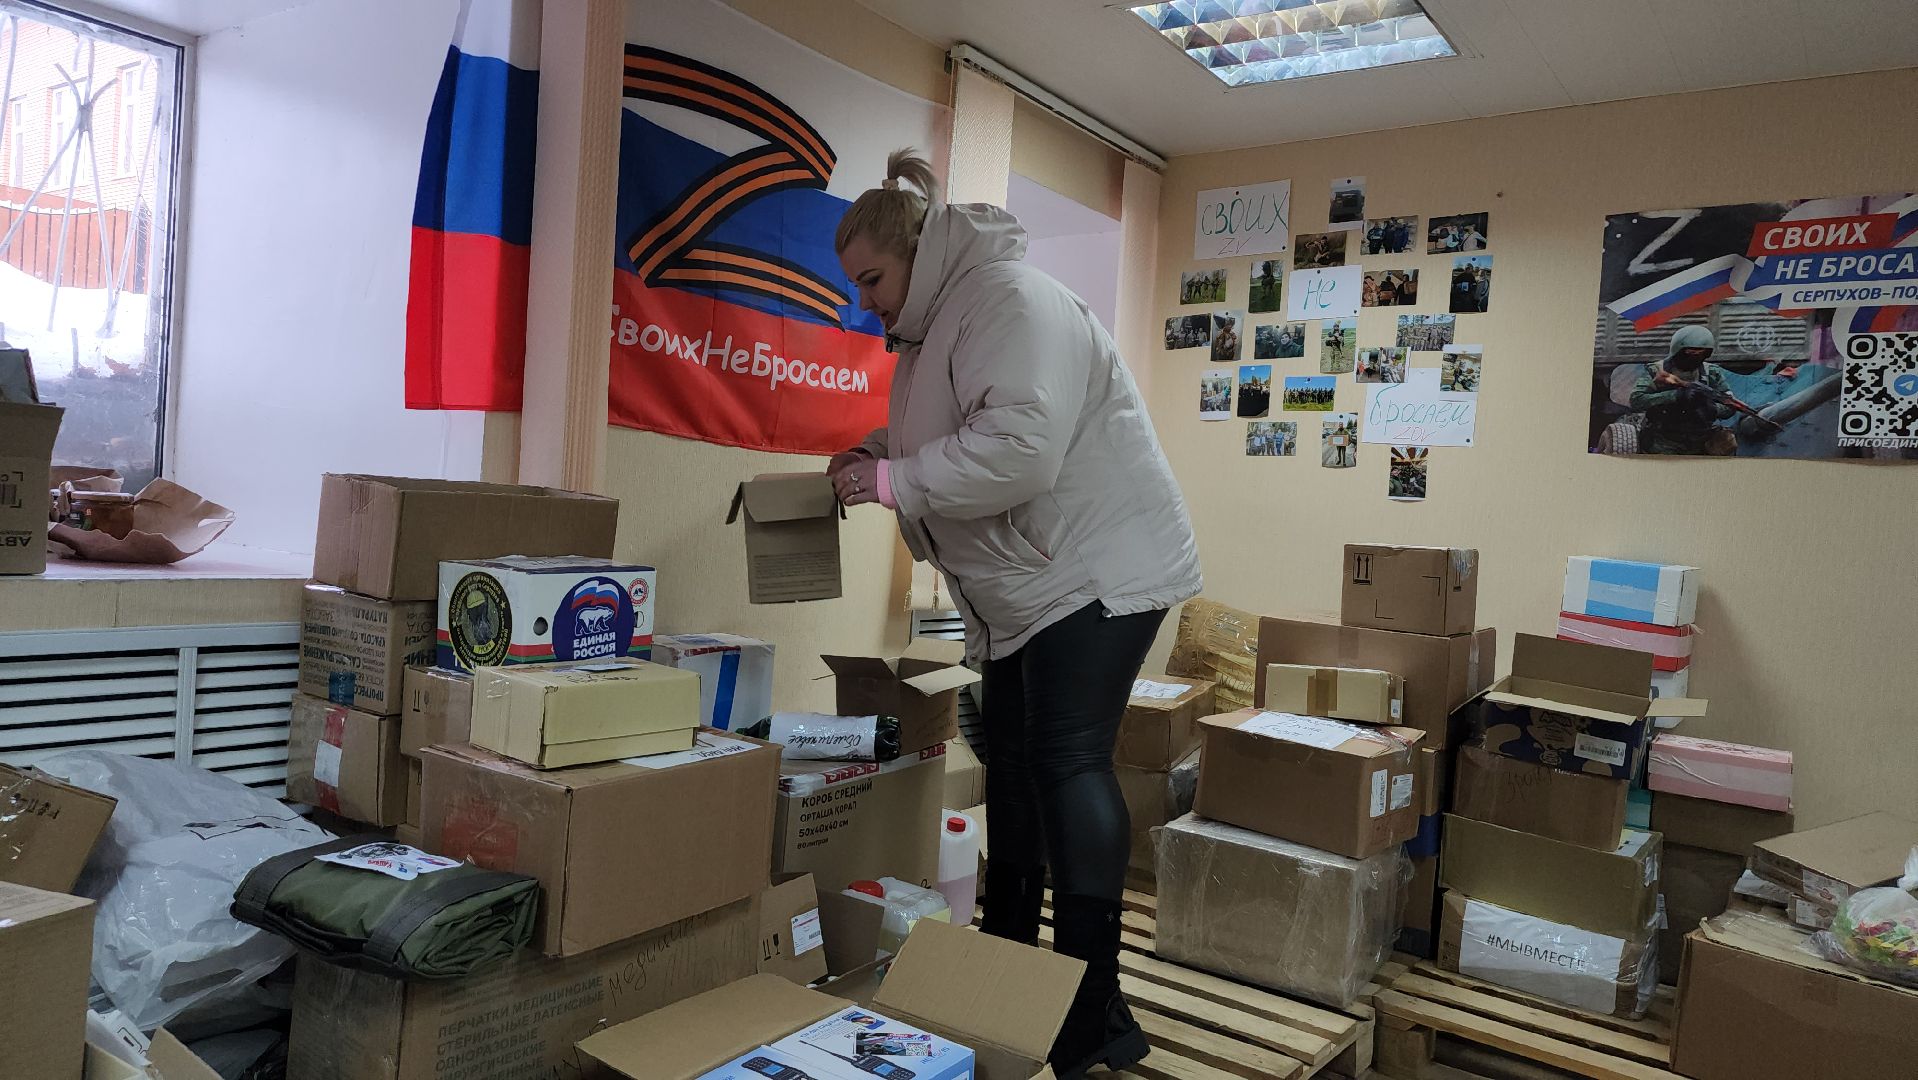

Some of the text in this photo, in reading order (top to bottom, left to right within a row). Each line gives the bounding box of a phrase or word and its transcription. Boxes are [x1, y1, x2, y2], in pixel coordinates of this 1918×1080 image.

[1201, 191, 1289, 236] СВОИХ
[1763, 221, 1872, 251] СВОИХ
[1774, 252, 1918, 281] НЕ БРОСА
[1792, 285, 1918, 304] СЕРПУХОВ-ПО
[609, 304, 869, 394] воихНеБросаем
[573, 632, 616, 649] ЕДИНАЯ
[573, 643, 616, 660] РОССИЯ
[801, 778, 873, 808] КОРОБ СРЕДНИЙ
[800, 809, 834, 823] ОРТАША
[1486, 933, 1586, 972] #МЫВМЕСТЕ
[438, 1005, 510, 1039] ПЕРЧАТКИ
[511, 975, 604, 1013] МЕДИЦИНСКИЕ
[436, 1013, 531, 1057] СТЕРИЛЬНЫЕ
[532, 990, 606, 1024] ЛАТЕКСНЫЕ
[434, 1026, 539, 1073] ОДНОРАЗОВЫЕ
